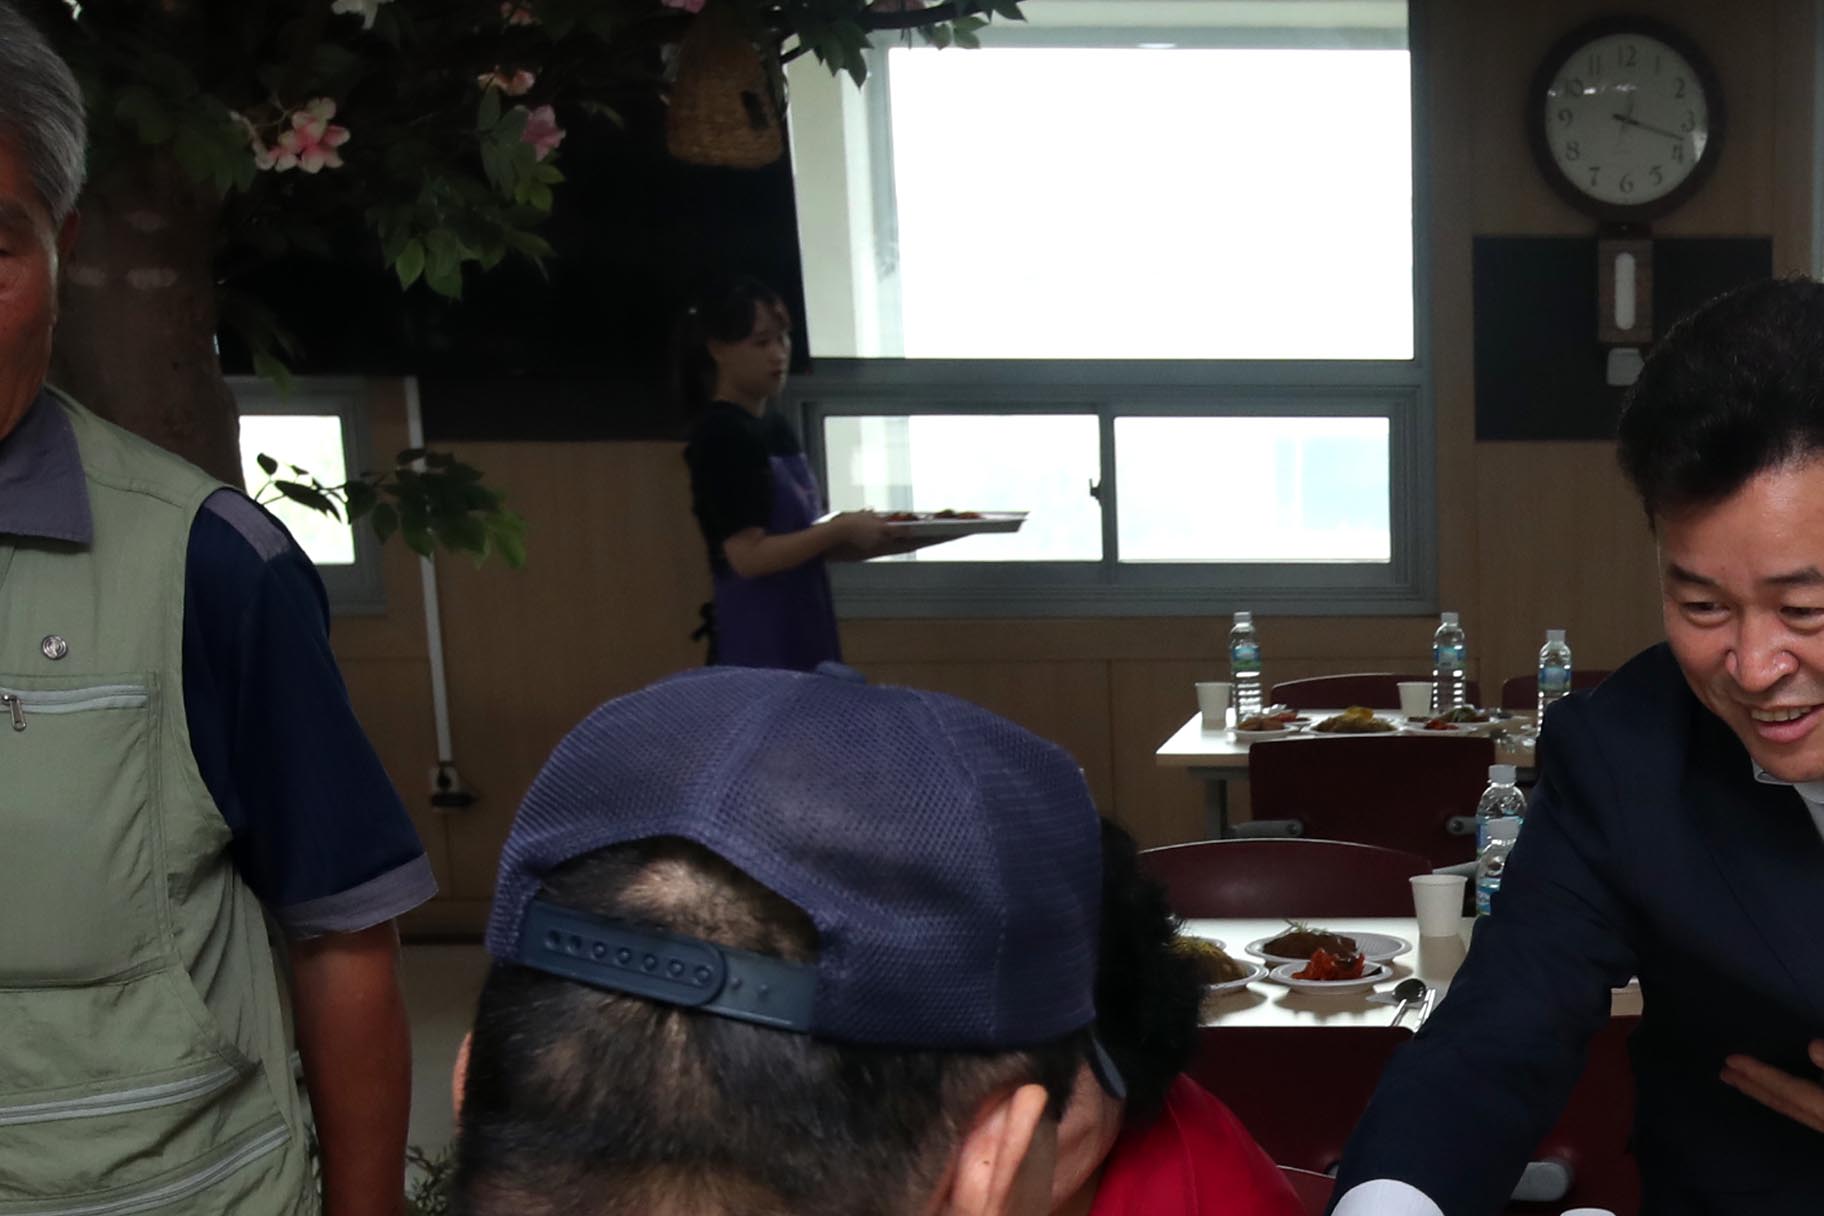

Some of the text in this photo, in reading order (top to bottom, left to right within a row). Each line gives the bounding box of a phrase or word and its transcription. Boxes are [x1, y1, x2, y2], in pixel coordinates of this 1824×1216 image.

[1618, 44, 1637, 67] 12
[1673, 77, 1686, 99] 2
[1557, 109, 1574, 127] 9
[1680, 109, 1696, 132] 3
[1565, 141, 1580, 161] 8
[1588, 167, 1601, 187] 7
[1619, 173, 1634, 193] 6
[1649, 165, 1663, 186] 5
